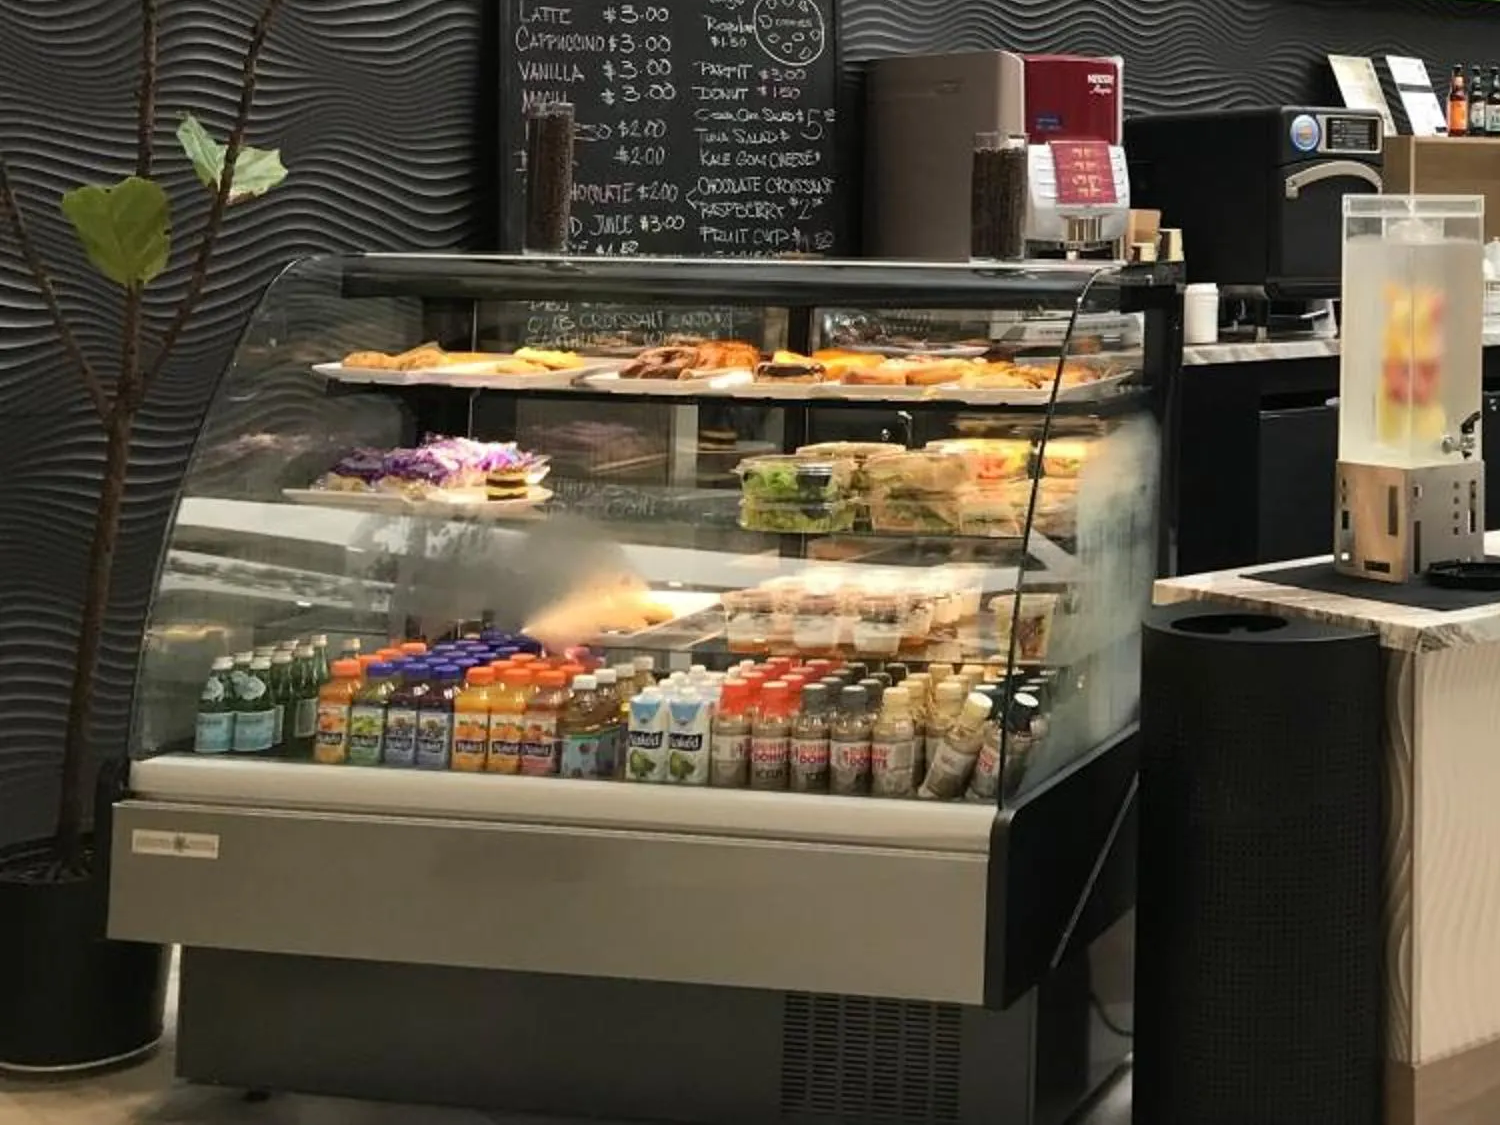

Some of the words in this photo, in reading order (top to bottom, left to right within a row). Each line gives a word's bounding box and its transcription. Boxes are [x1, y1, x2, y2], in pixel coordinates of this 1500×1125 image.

[519, 0, 572, 24] LATTE
[603, 4, 669, 24] $3.00
[515, 25, 605, 52] CAPPUCCINO
[607, 33, 671, 54] $3.00
[518, 60, 585, 83] VANILLA
[602, 58, 672, 83] $3.00
[601, 82, 677, 106] $3.00
[691, 86, 749, 100] DONUT
[618, 119, 667, 138] $2.00
[732, 128, 779, 144] SALAD
[613, 145, 665, 166] $2.00
[700, 148, 731, 166] KALE
[571, 182, 635, 204] HOCOLATE
[640, 215, 685, 233] $3.00
[698, 226, 749, 243] FRUIT
[753, 229, 789, 245] CUP
